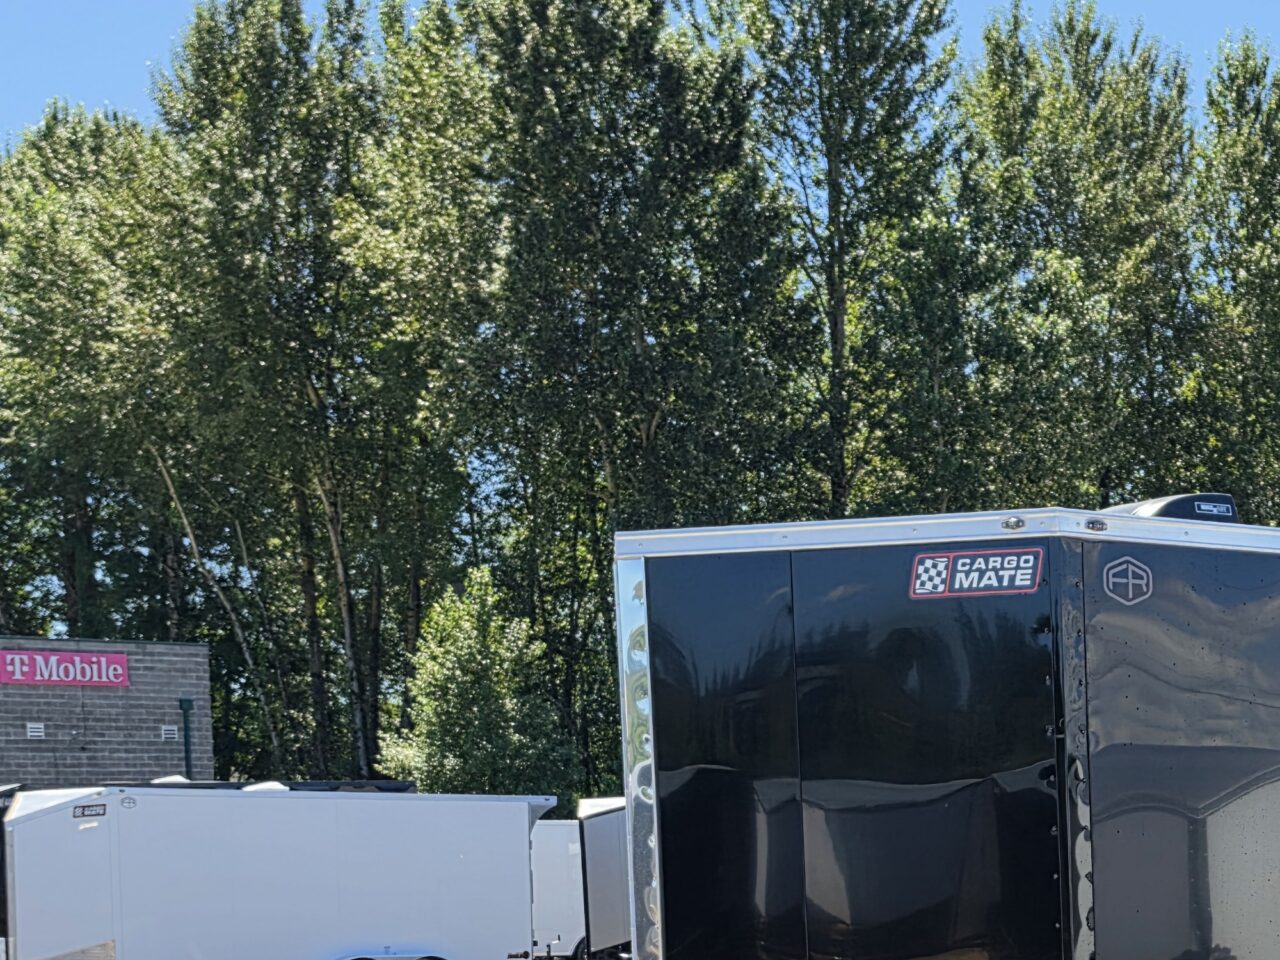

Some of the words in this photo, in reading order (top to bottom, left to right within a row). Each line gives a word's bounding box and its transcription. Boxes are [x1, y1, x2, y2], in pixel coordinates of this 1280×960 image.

[957, 555, 1034, 571] CARGO
[954, 569, 1033, 589] MATE
[33, 655, 124, 682] Mobile
